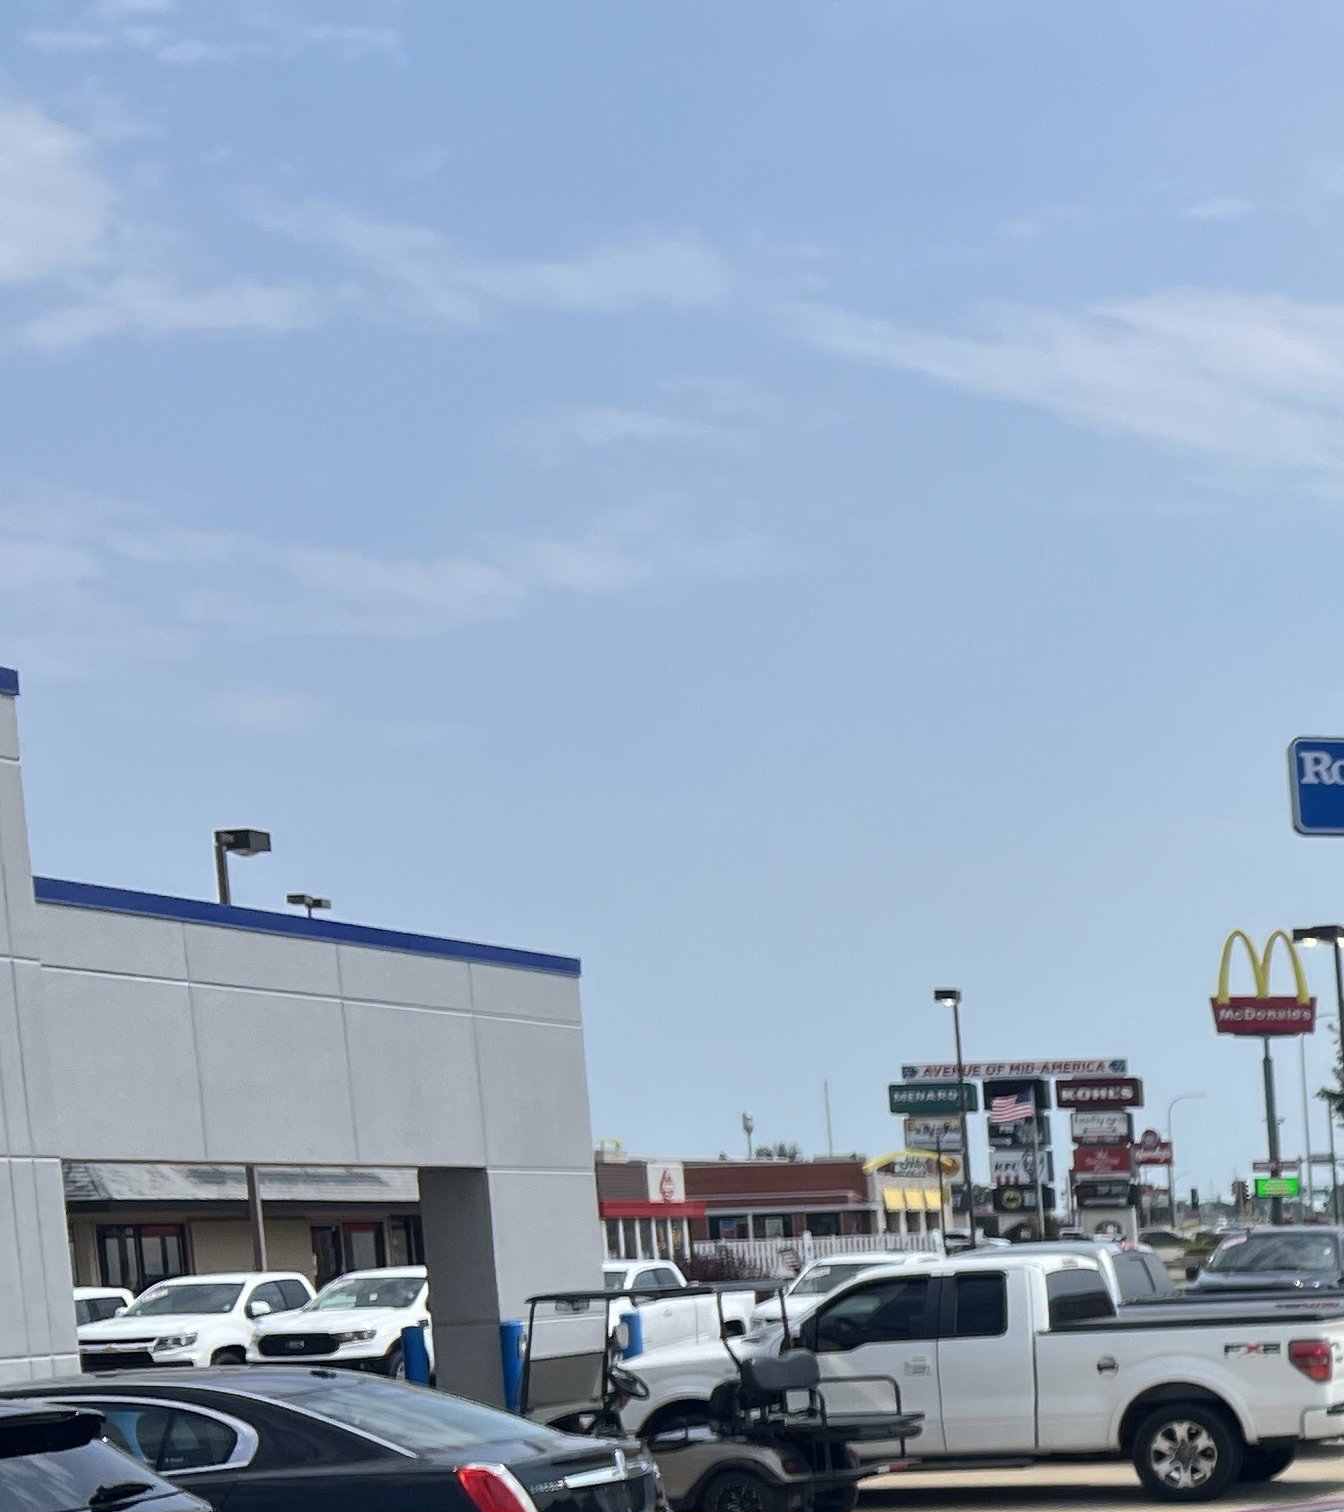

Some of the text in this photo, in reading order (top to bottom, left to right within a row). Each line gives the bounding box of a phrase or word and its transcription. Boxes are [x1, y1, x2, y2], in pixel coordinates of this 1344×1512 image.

[1218, 1006, 1312, 1023] McDonald's
[984, 1063, 1006, 1076] OF
[1008, 1060, 1106, 1076] MID-AMERICA
[892, 1087, 966, 1104] MENARD
[1060, 1085, 1134, 1102] KOHL'S
